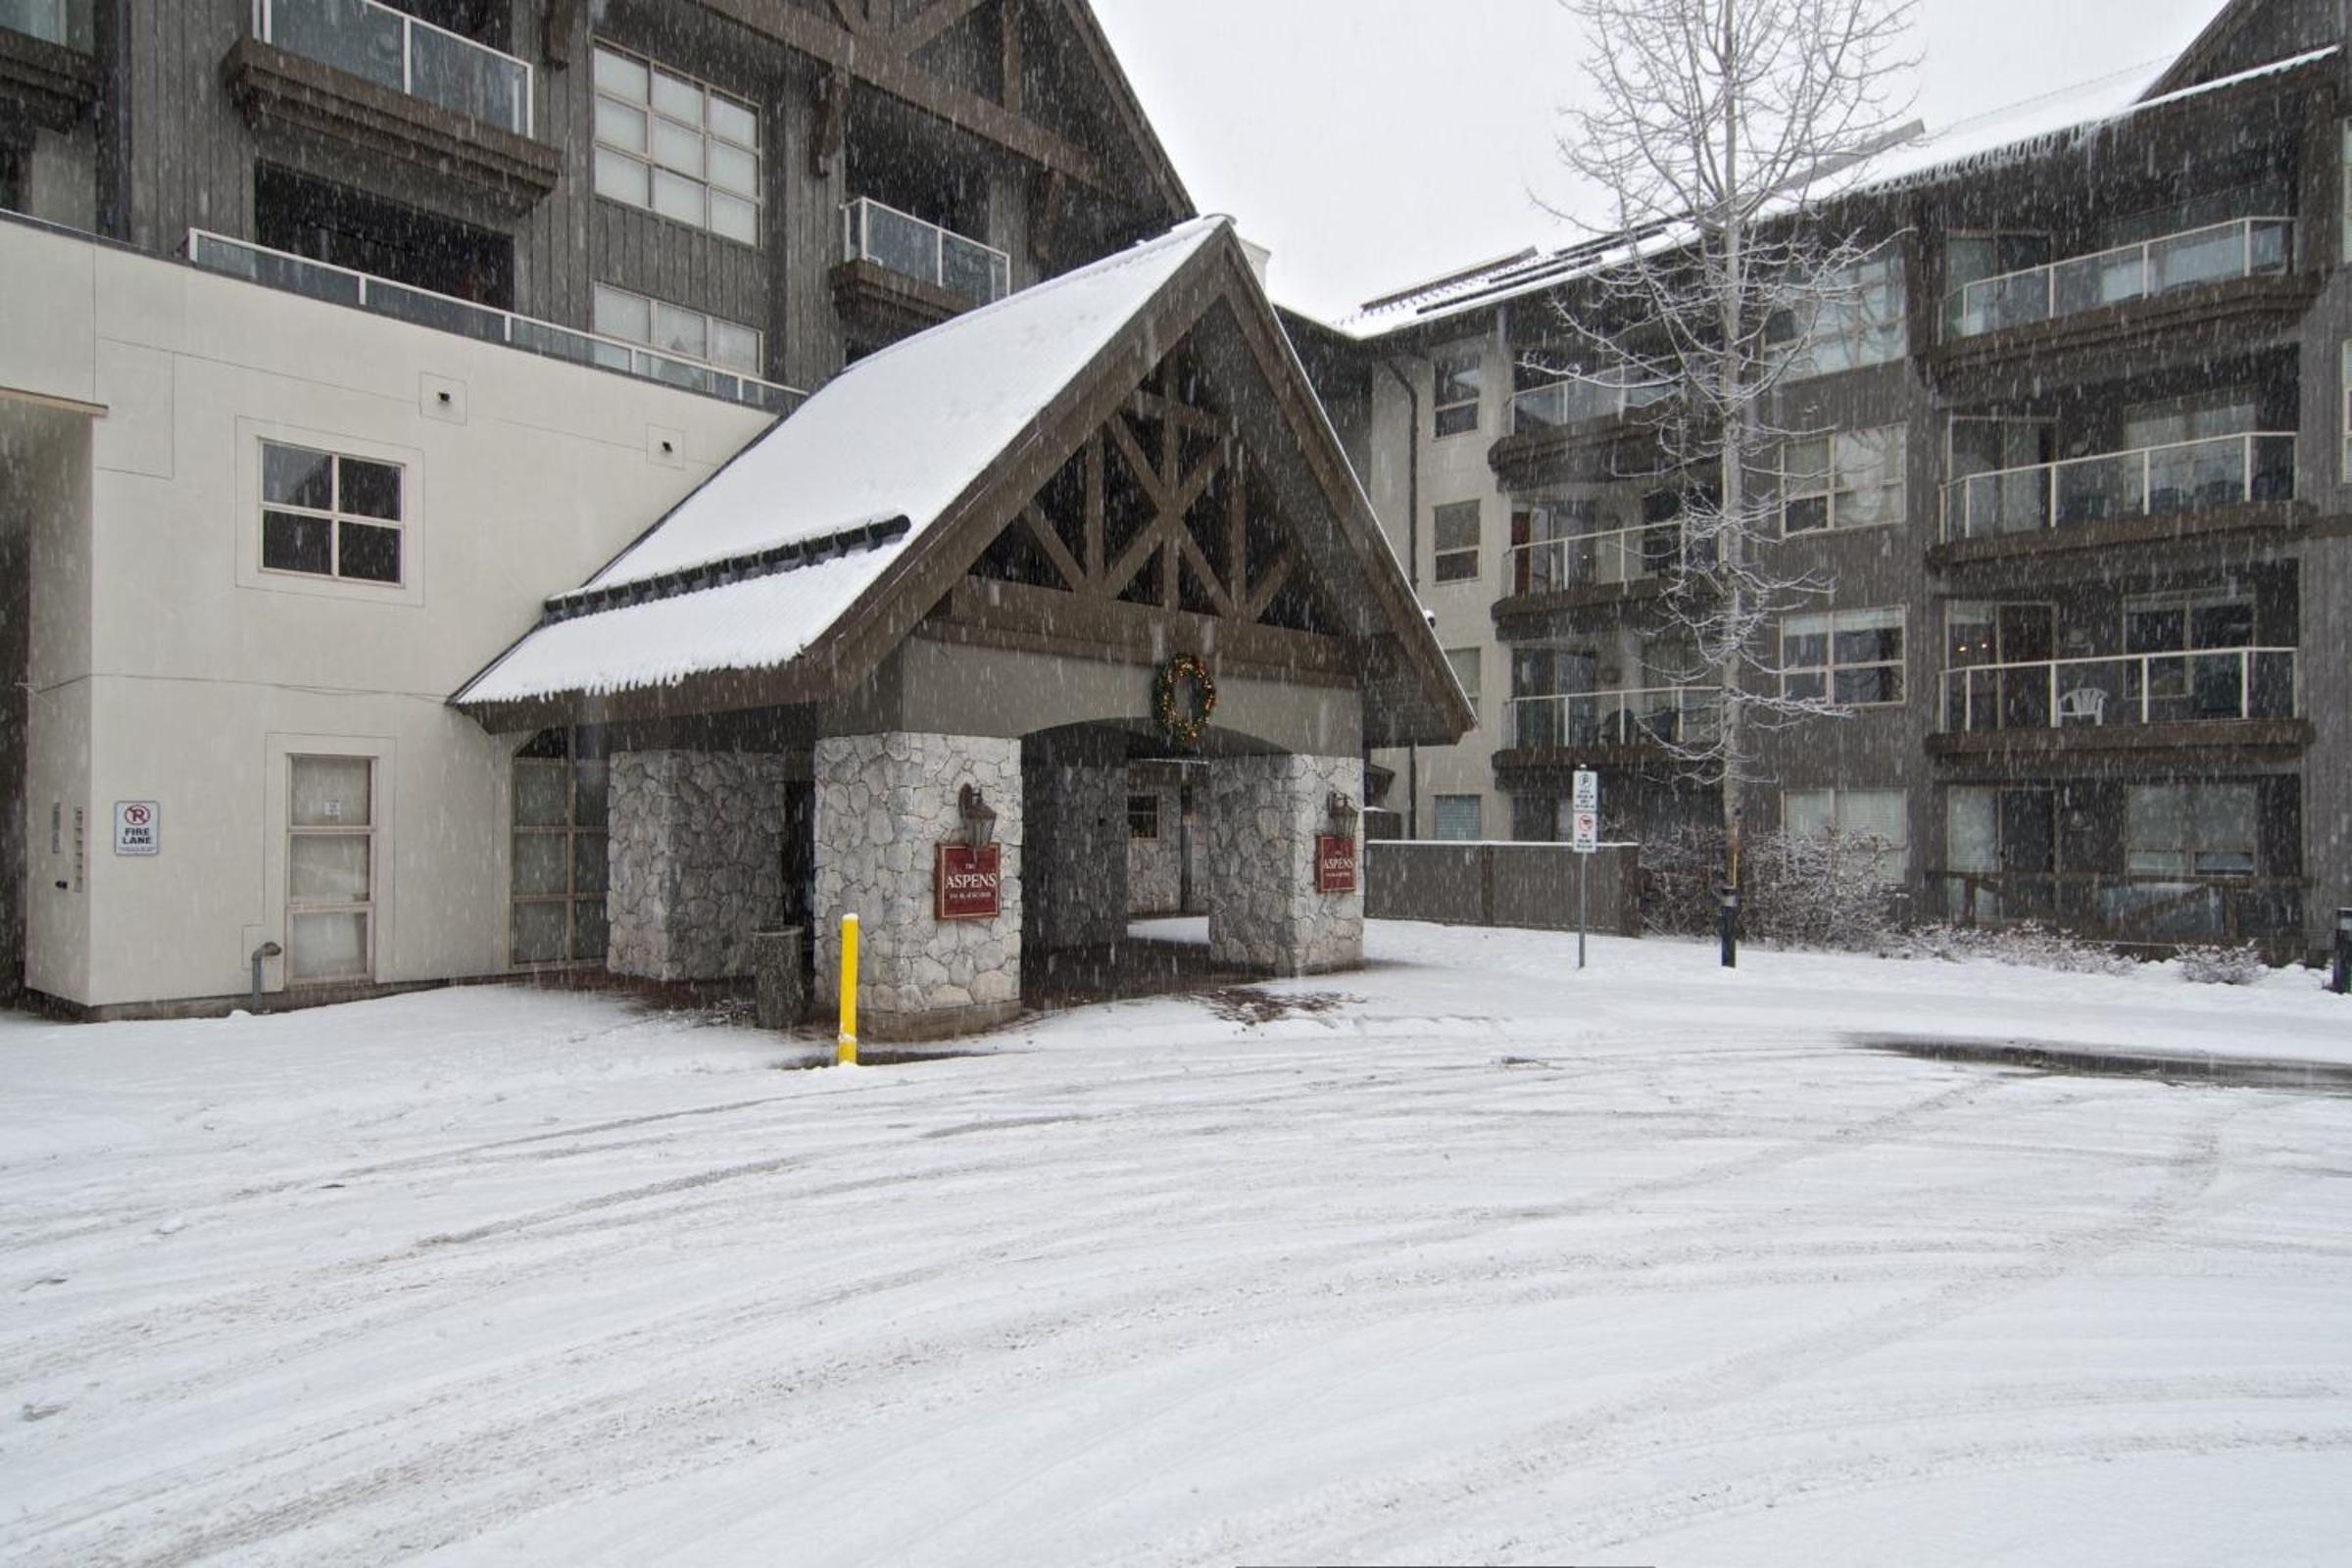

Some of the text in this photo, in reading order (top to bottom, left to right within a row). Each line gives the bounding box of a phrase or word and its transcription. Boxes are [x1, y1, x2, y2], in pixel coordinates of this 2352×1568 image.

[125, 827, 150, 836] FIRE
[1324, 858, 1354, 869] ASPENS
[945, 873, 997, 889] ASPENS
